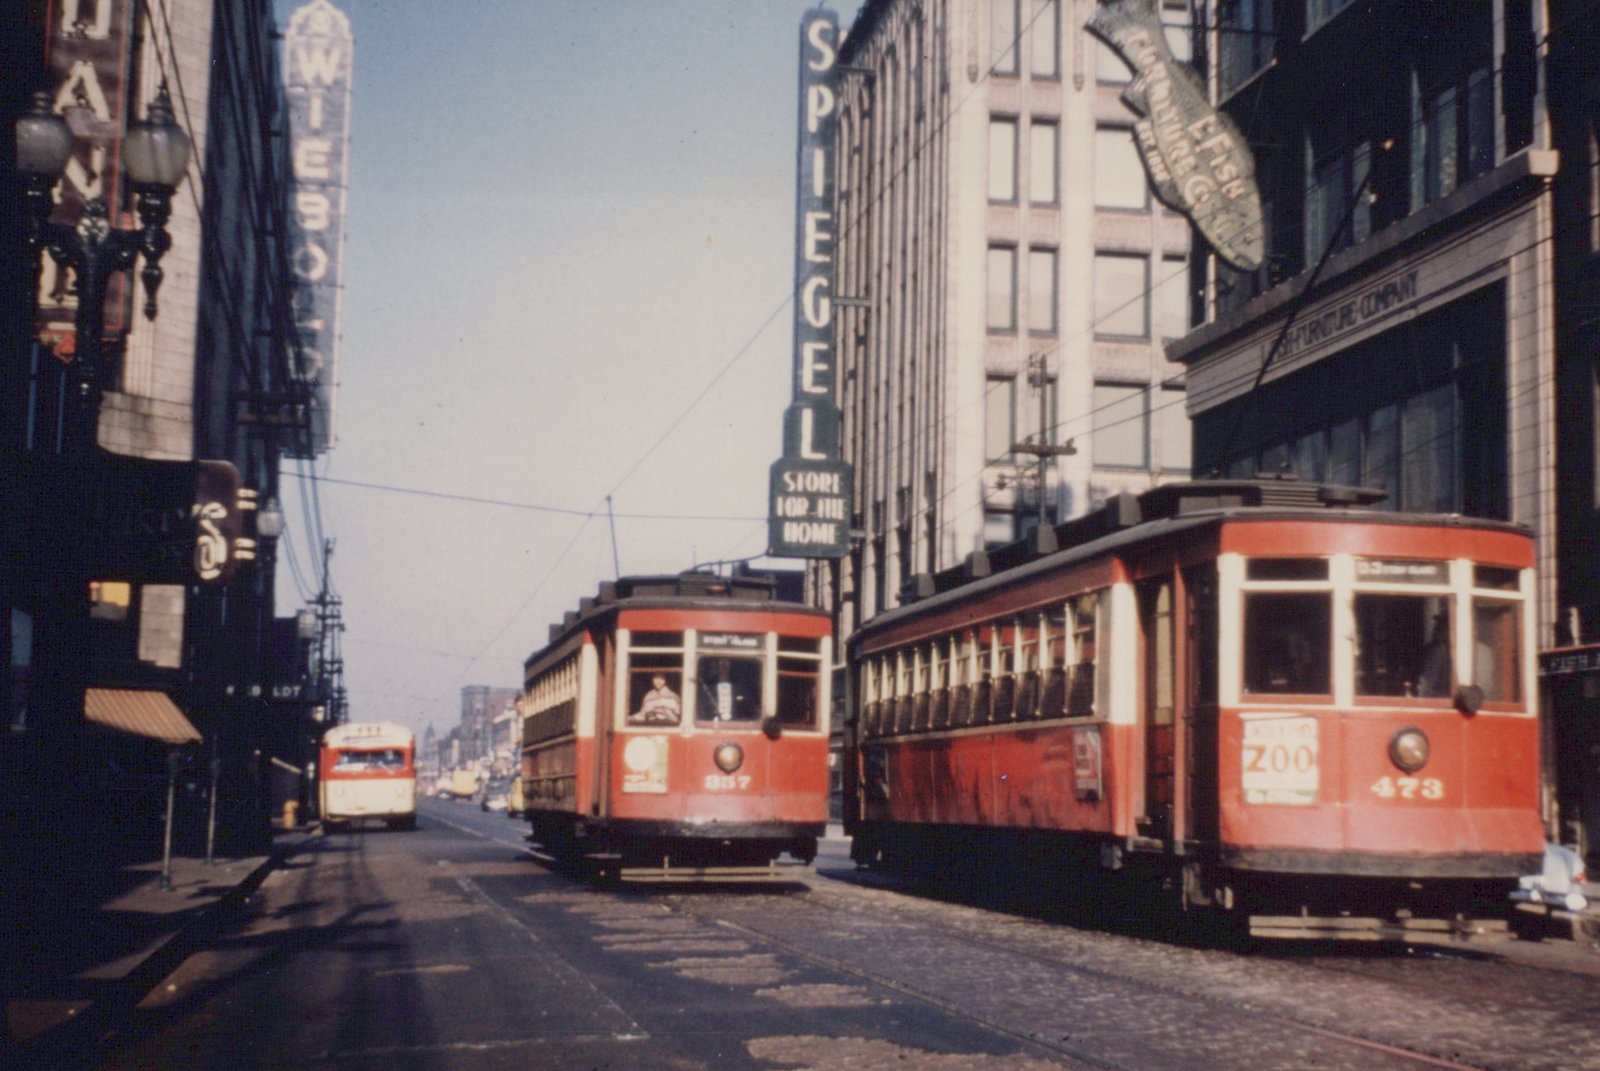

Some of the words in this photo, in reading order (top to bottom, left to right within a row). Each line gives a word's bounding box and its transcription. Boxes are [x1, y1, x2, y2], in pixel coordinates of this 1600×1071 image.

[1126, 28, 1197, 177] FURNITURE
[1195, 132, 1246, 200] FISH
[801, 18, 835, 460] SPIEGEL
[1360, 269, 1419, 319] COMPANY
[783, 470, 843, 495] STORE
[776, 496, 809, 518] FOR
[815, 497, 848, 521] THE
[783, 521, 840, 545] HOME
[1370, 776, 1444, 799] 473
